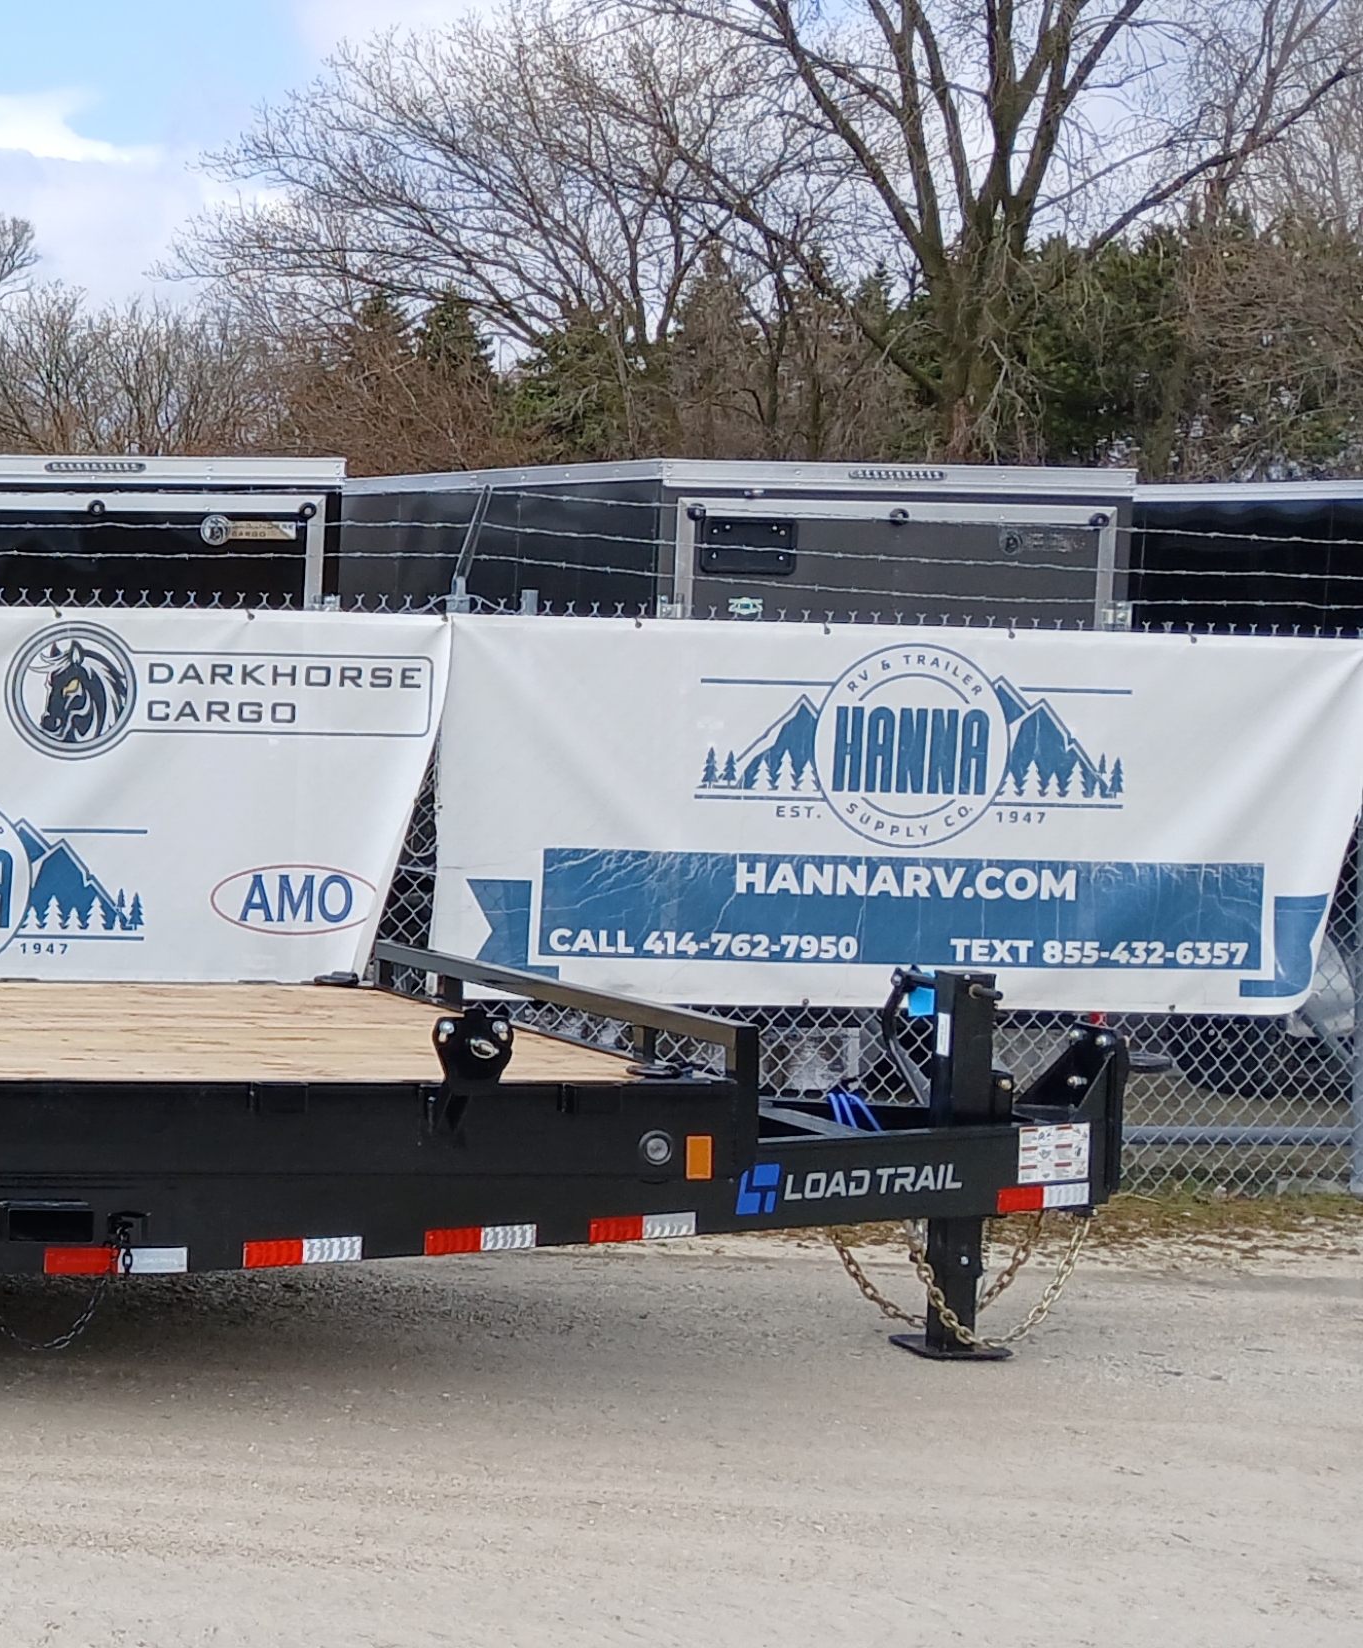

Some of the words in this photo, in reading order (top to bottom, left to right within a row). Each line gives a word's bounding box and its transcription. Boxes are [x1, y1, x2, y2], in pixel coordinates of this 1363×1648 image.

[148, 662, 422, 689] DARKHORSE
[846, 670, 869, 693] RV
[881, 660, 891, 671] &
[903, 655, 983, 696] TRAILER
[146, 700, 297, 724] CARGO
[832, 706, 990, 796] HANNA
[775, 805, 822, 819] EST.
[846, 802, 929, 838] SUPPLY
[944, 805, 973, 828] CO.
[996, 811, 1046, 825] 1947
[737, 862, 1076, 901] HANNARV.COM
[238, 874, 353, 923] AMO
[20, 943, 68, 955] 1947
[549, 928, 635, 954] CALL
[643, 932, 858, 960] 414-762-7950
[950, 938, 1033, 963] TEXT
[1042, 940, 1249, 965] 855-432-6357
[784, 1169, 871, 1201] LOAD
[876, 1163, 963, 1194] TRAIL
